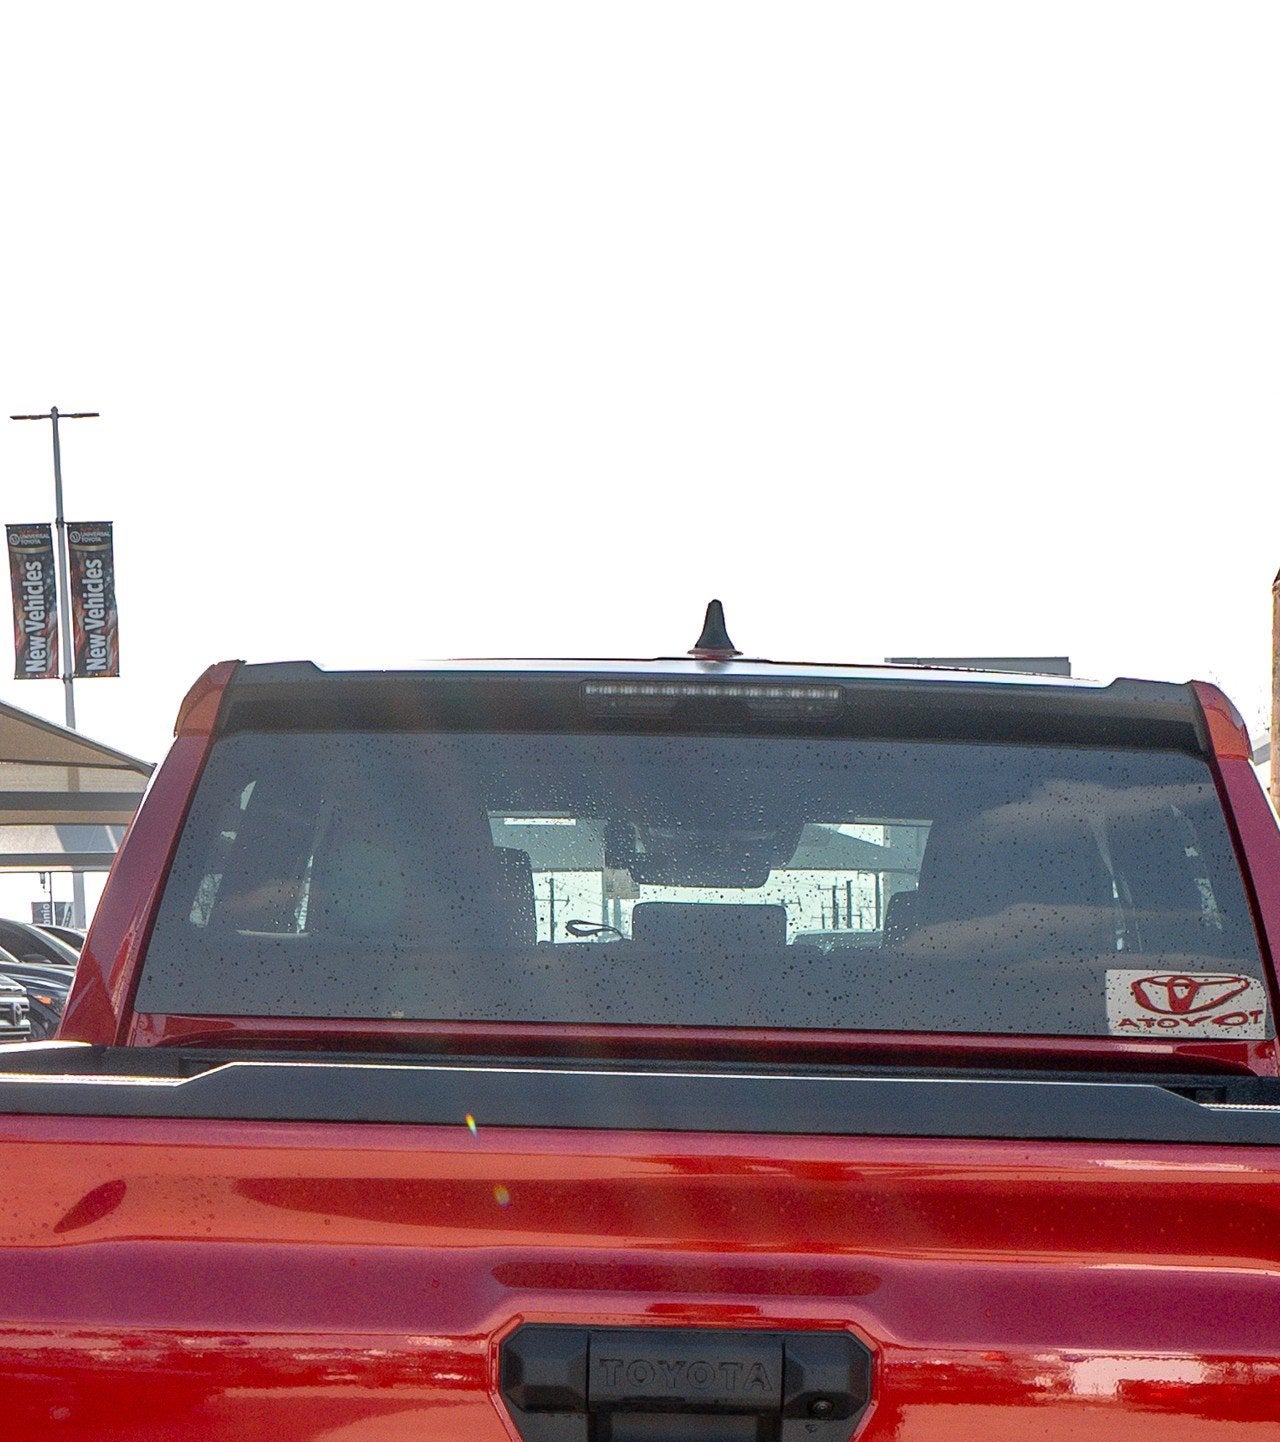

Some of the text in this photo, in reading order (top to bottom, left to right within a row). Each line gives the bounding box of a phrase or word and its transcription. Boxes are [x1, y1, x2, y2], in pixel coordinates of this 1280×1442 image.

[22, 560, 46, 633] Vehicles
[81, 558, 105, 631] Vehicles
[25, 635, 47, 673] New
[86, 634, 107, 671] New
[599, 1358, 773, 1392] TOYOTA
